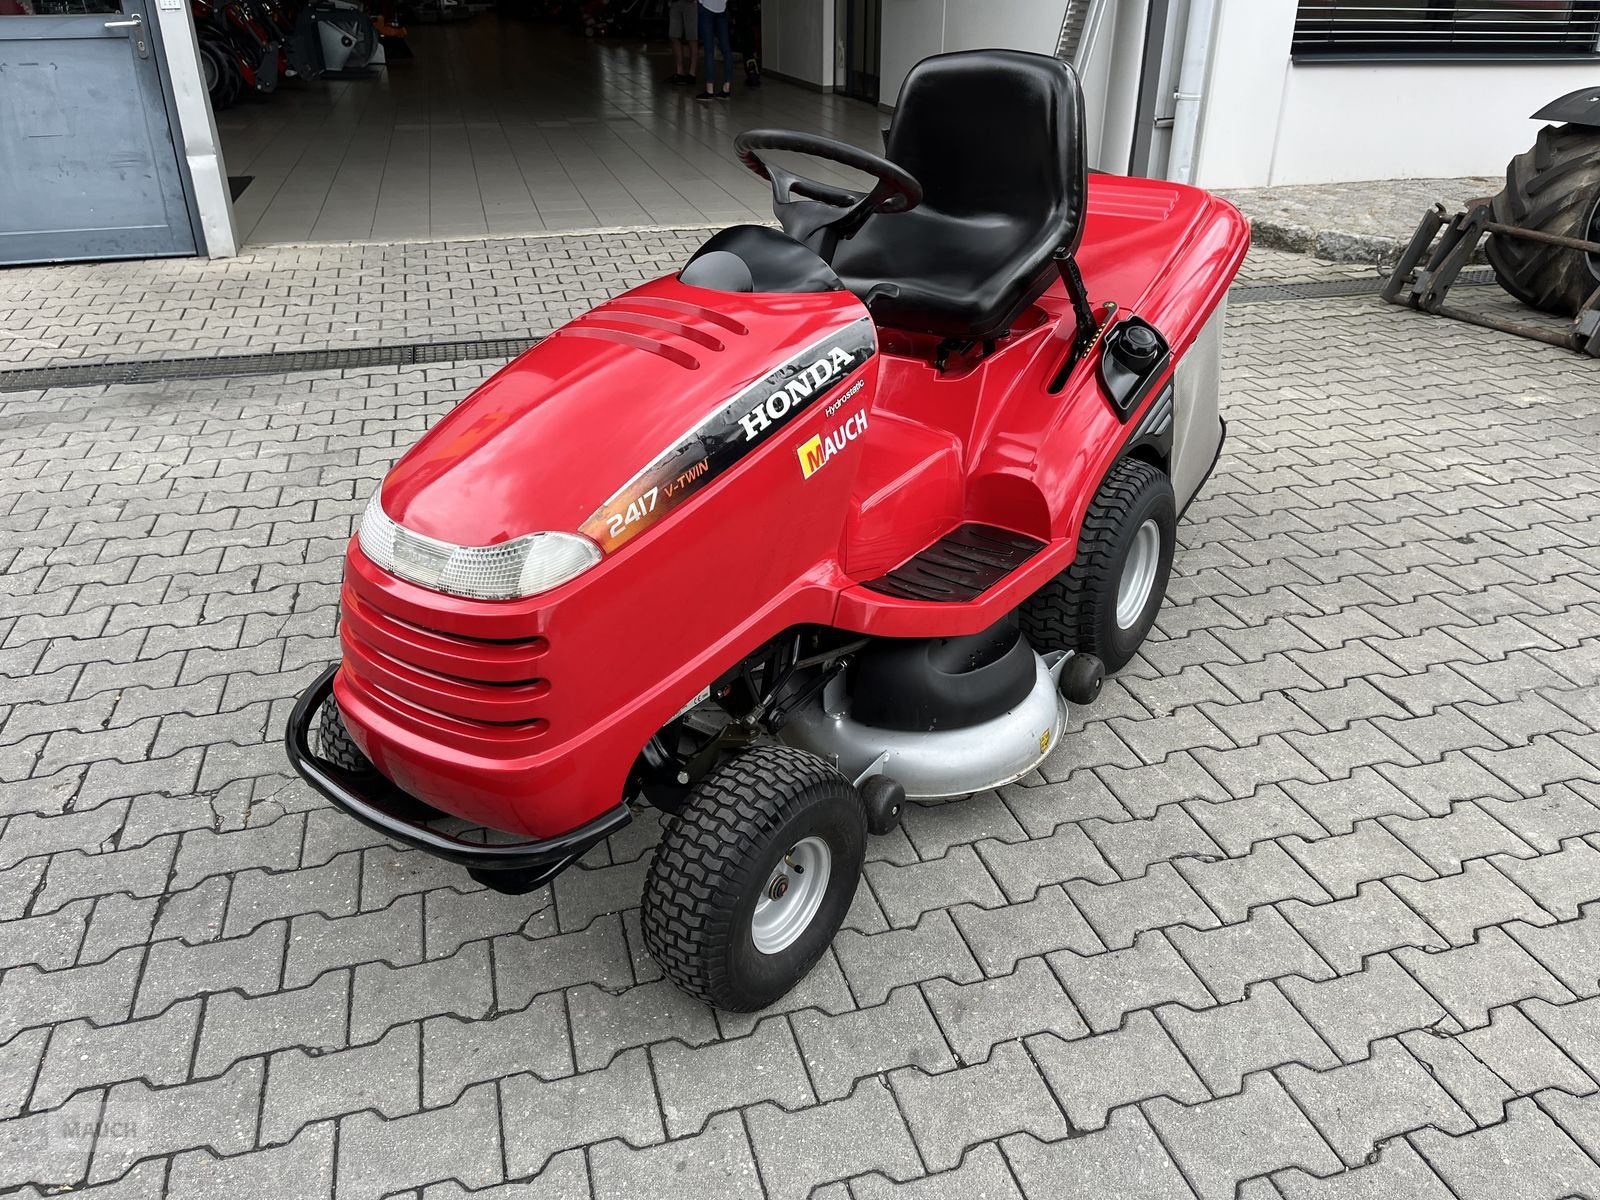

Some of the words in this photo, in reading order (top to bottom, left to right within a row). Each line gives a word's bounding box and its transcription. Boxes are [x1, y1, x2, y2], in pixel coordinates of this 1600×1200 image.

[738, 347, 855, 441] HONDA
[825, 379, 865, 417] Hydrostatic
[805, 408, 868, 473] MAUCH
[606, 486, 659, 538] 2417
[663, 456, 710, 498] V-TWIN
